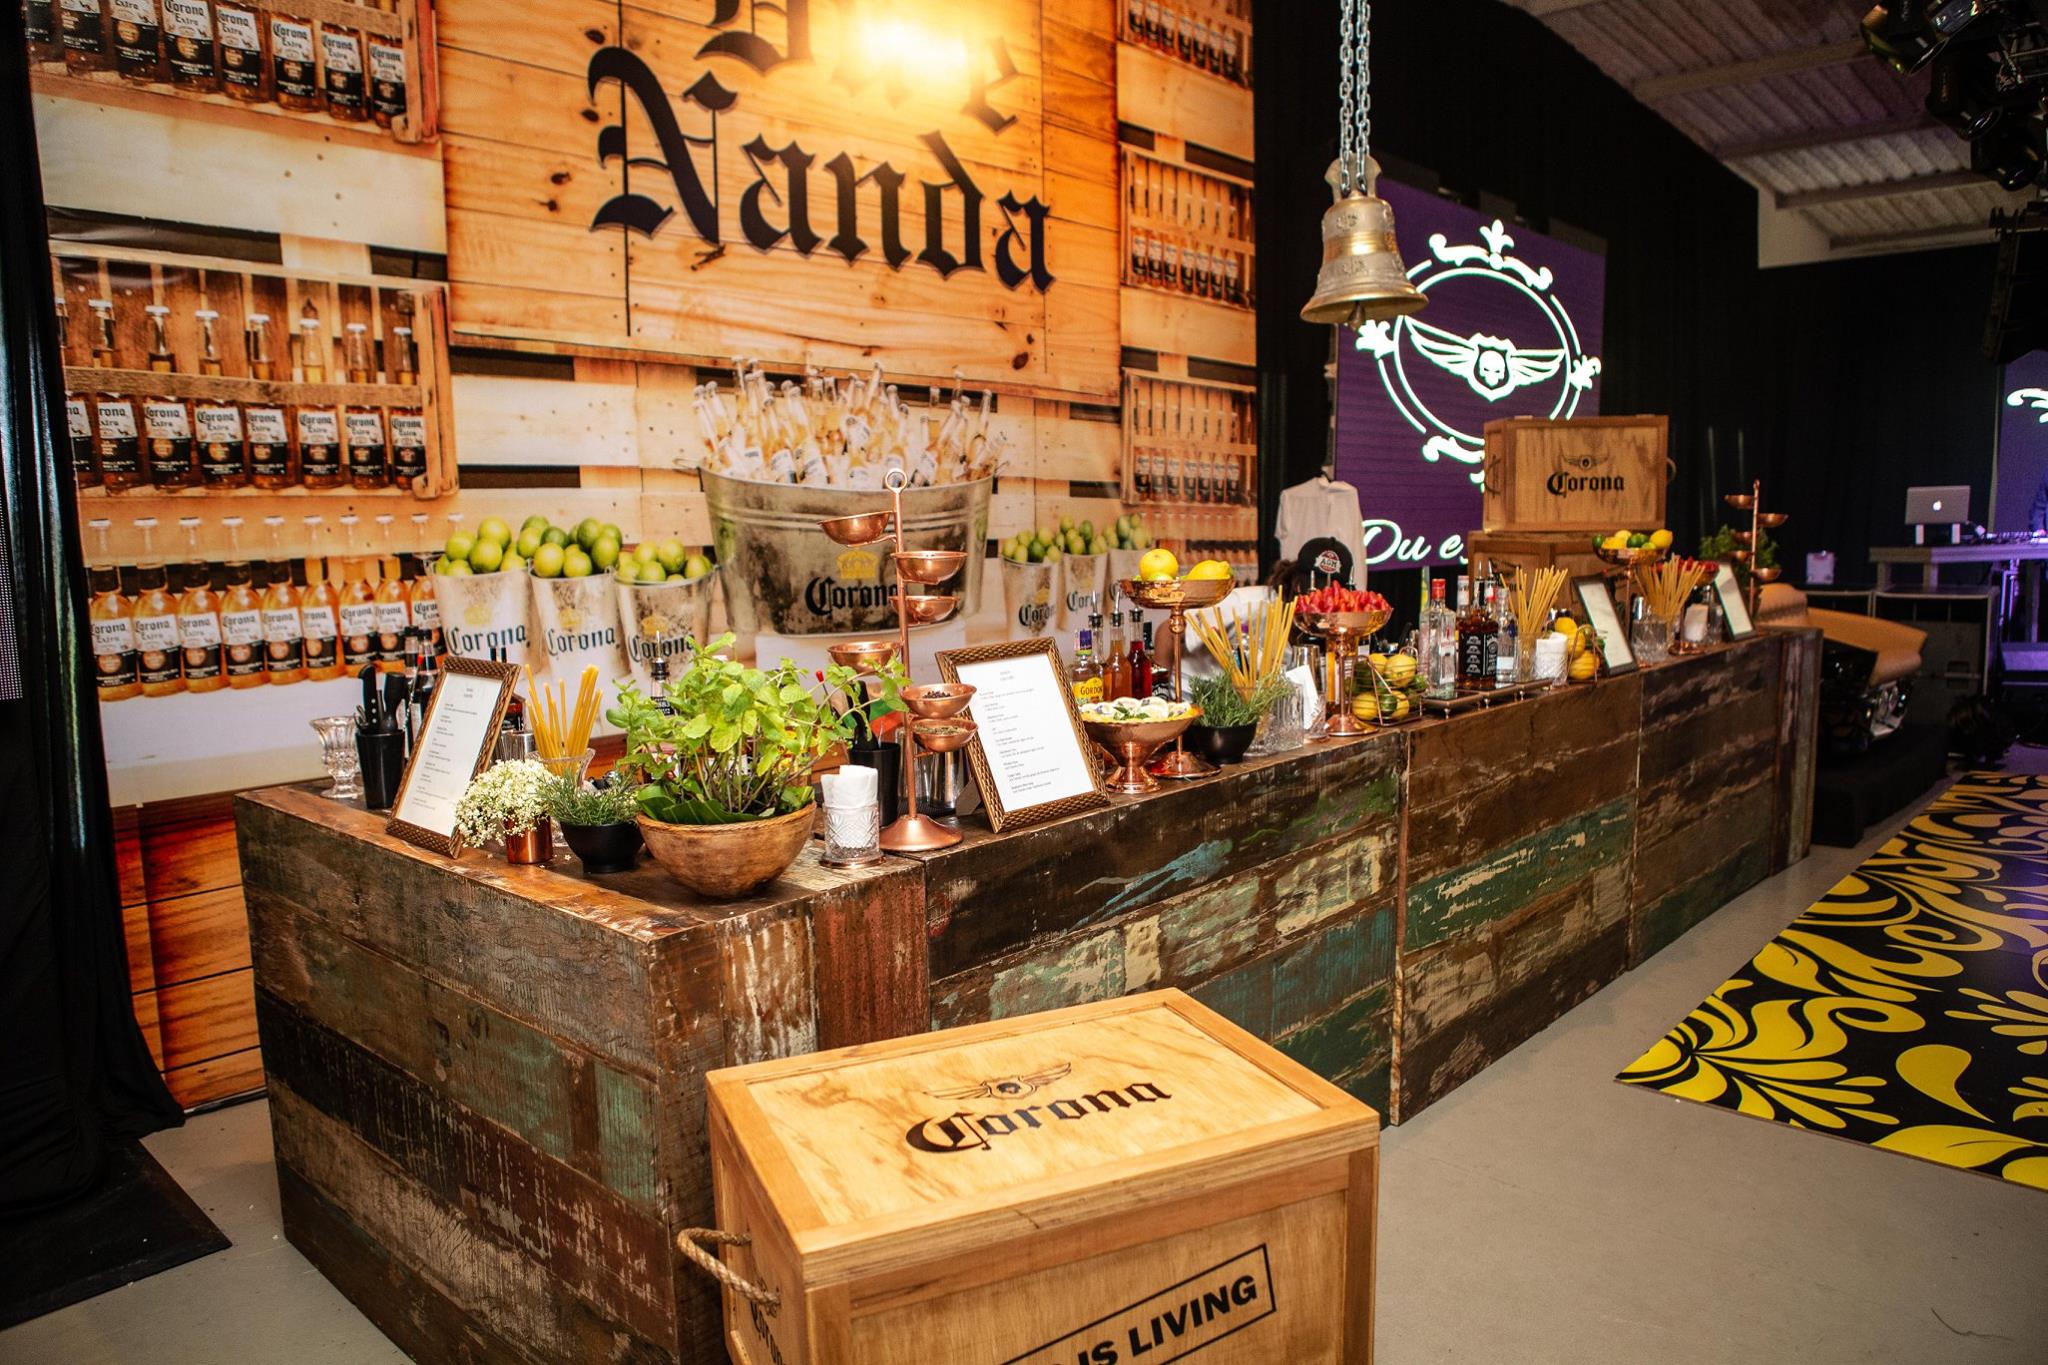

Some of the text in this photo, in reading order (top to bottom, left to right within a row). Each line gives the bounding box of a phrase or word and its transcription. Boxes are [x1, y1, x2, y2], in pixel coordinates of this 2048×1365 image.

[164, 0, 204, 16] Corona
[175, 13, 199, 26] Extra
[217, 9, 250, 27] Corona
[273, 22, 309, 40] Corona
[588, 45, 1057, 293] Nanda
[99, 407, 126, 418] rona
[196, 409, 234, 423] Corona
[300, 414, 333, 426] Corona
[1546, 470, 1625, 498] Corona
[905, 1081, 1172, 1154] Corona
[1077, 1274, 1258, 1365] IS LIVING
